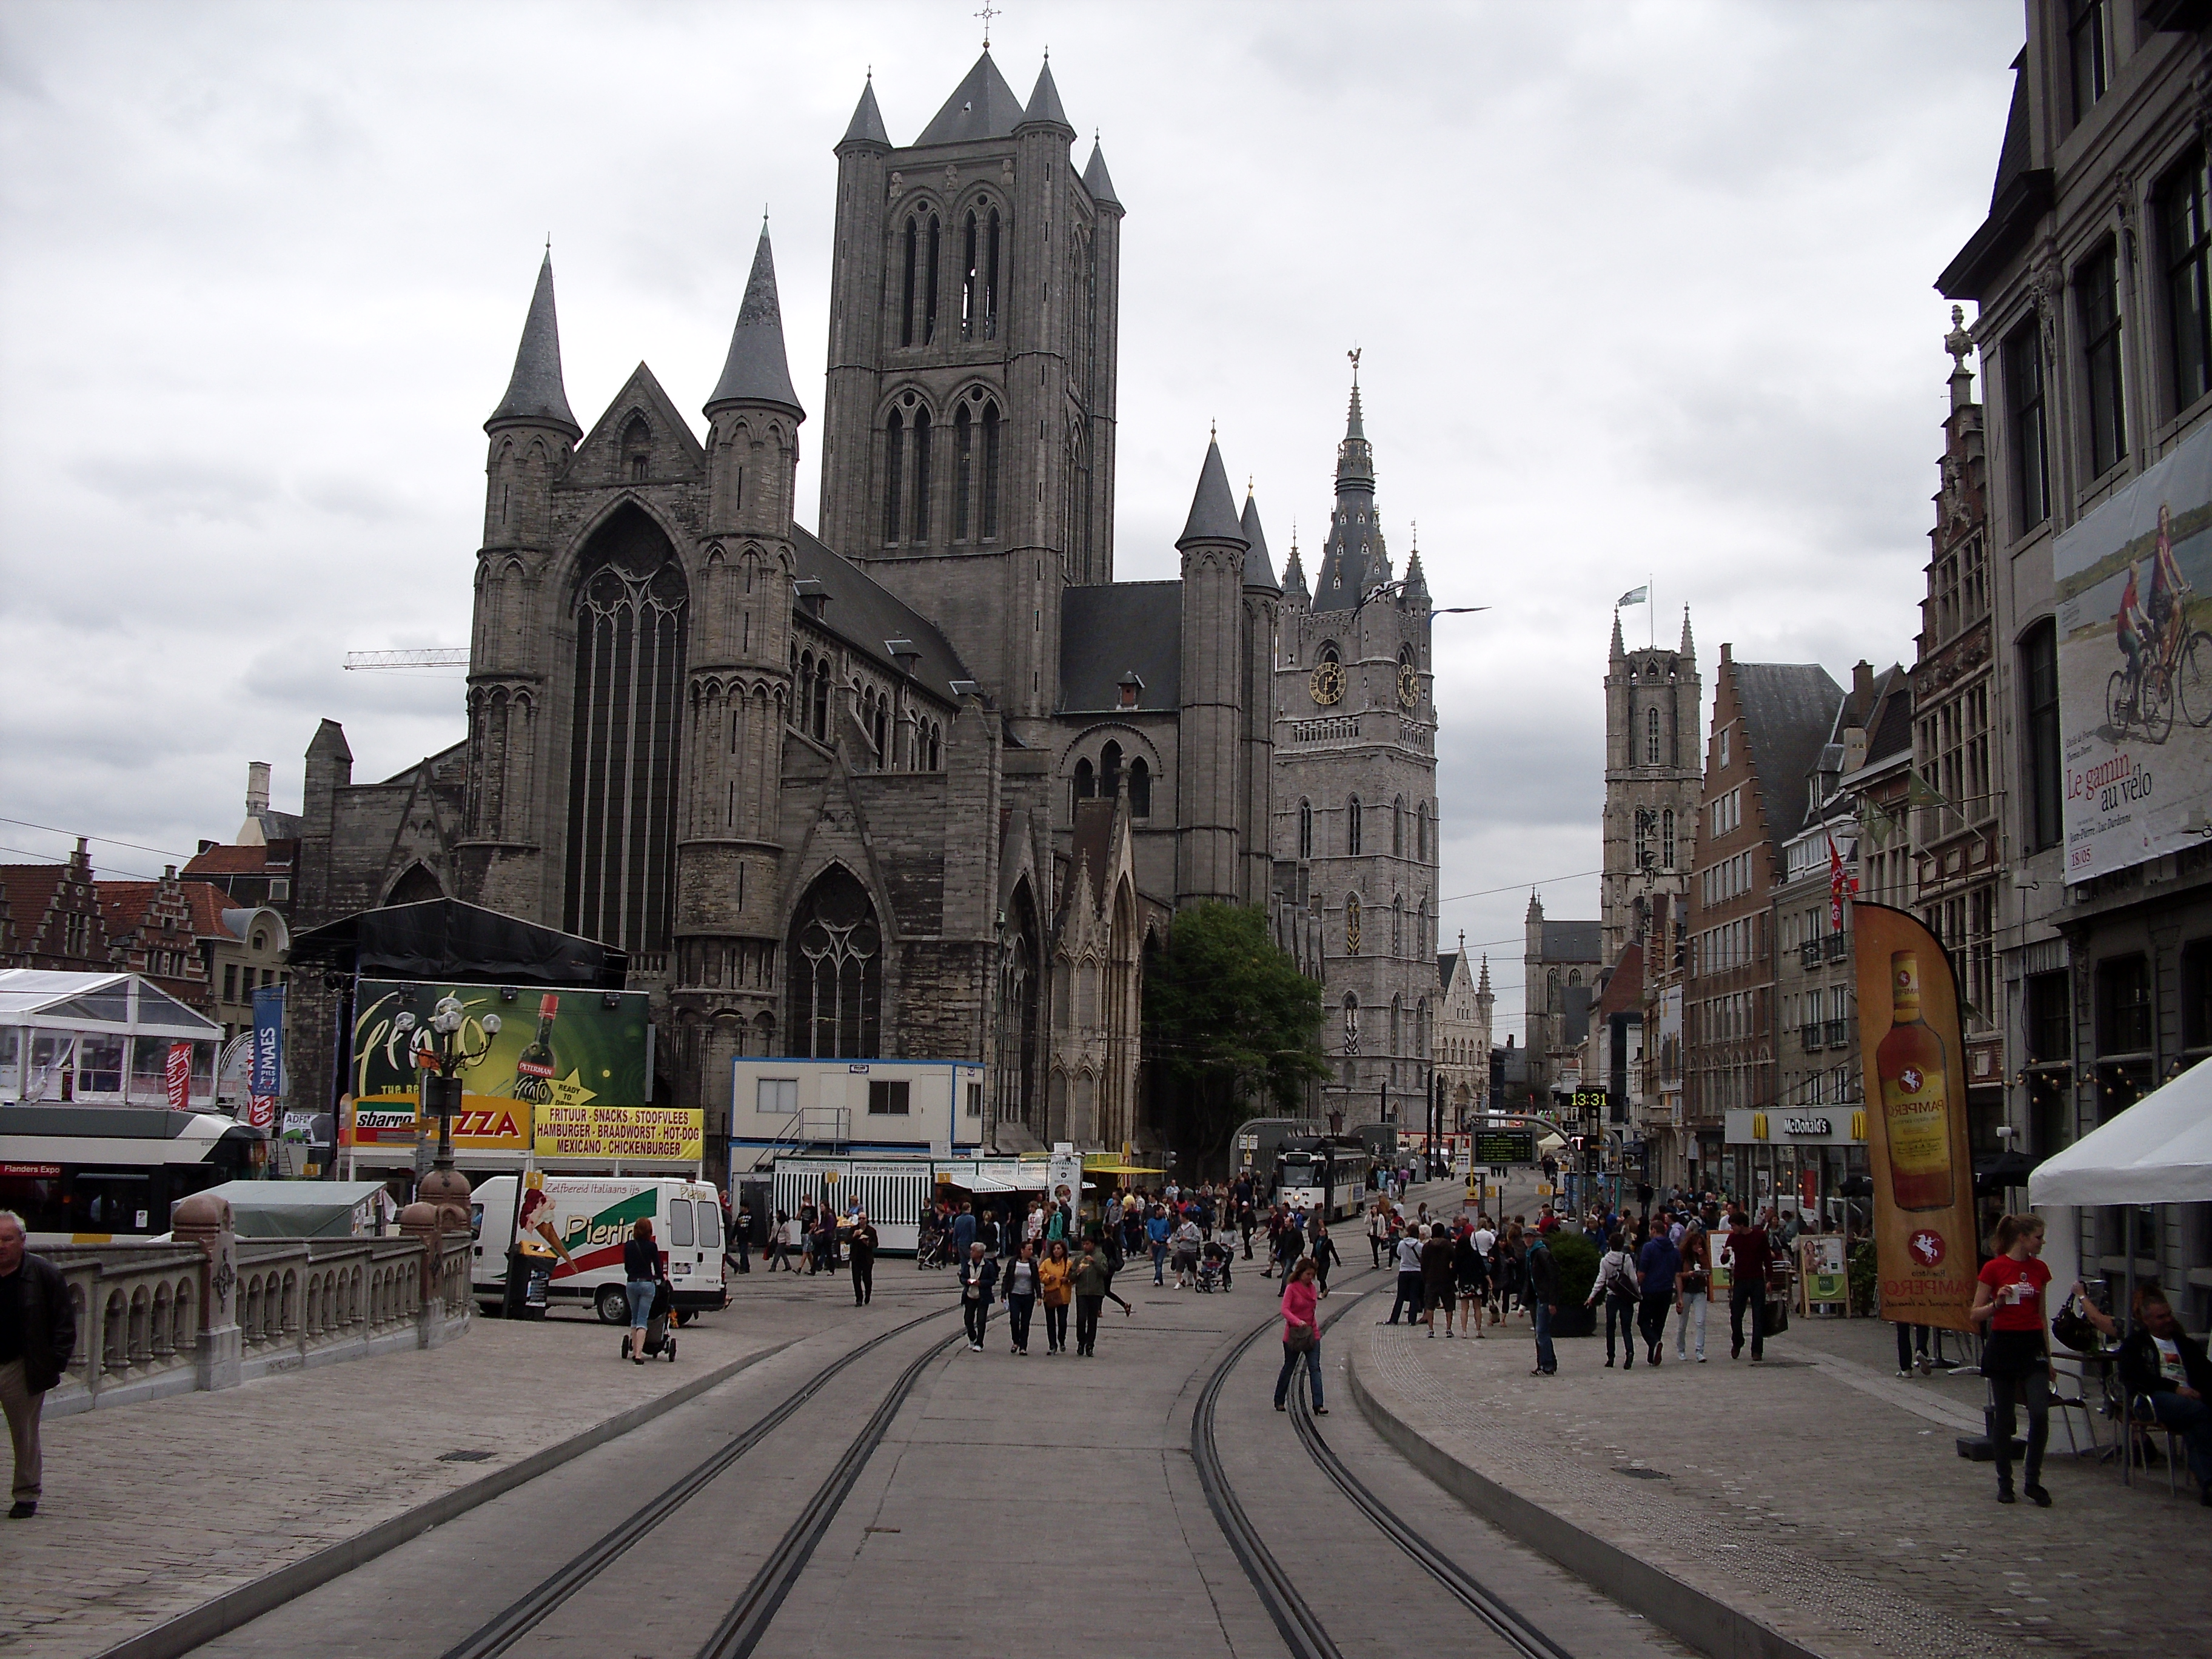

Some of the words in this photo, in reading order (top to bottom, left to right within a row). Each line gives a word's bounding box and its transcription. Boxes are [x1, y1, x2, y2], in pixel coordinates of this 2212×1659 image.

[2067, 769, 2082, 800] Le
[2086, 748, 2130, 800] gamin
[2101, 785, 2118, 812] au
[2121, 763, 2151, 803] vélo
[260, 1027, 275, 1070] MAES
[519, 1062, 552, 1076] PETERMAN
[558, 1084, 580, 1094] READY
[1572, 1093, 1606, 1106] 13:31
[357, 1111, 414, 1127] sbarro
[549, 1108, 586, 1122] FRITUUR
[594, 1108, 628, 1123] SNACKS
[635, 1110, 689, 1125] STOOFVLEES
[537, 1124, 591, 1138] HAMBURGER
[597, 1125, 656, 1139] BRAADWORST
[663, 1126, 700, 1141] HOT-DOG
[1784, 1118, 1827, 1134] McDonald's
[556, 1139, 602, 1153] MEXICANO
[608, 1141, 681, 1156] CHICKENBURGER
[4, 1165, 39, 1173] Flanders
[41, 1165, 60, 1174] Expo
[545, 1182, 589, 1194] Zelfbereid
[591, 1183, 627, 1194] Italiaans
[629, 1184, 640, 1196] ijs
[679, 1184, 706, 1200] Pierino
[565, 1214, 635, 1244] Pierin
